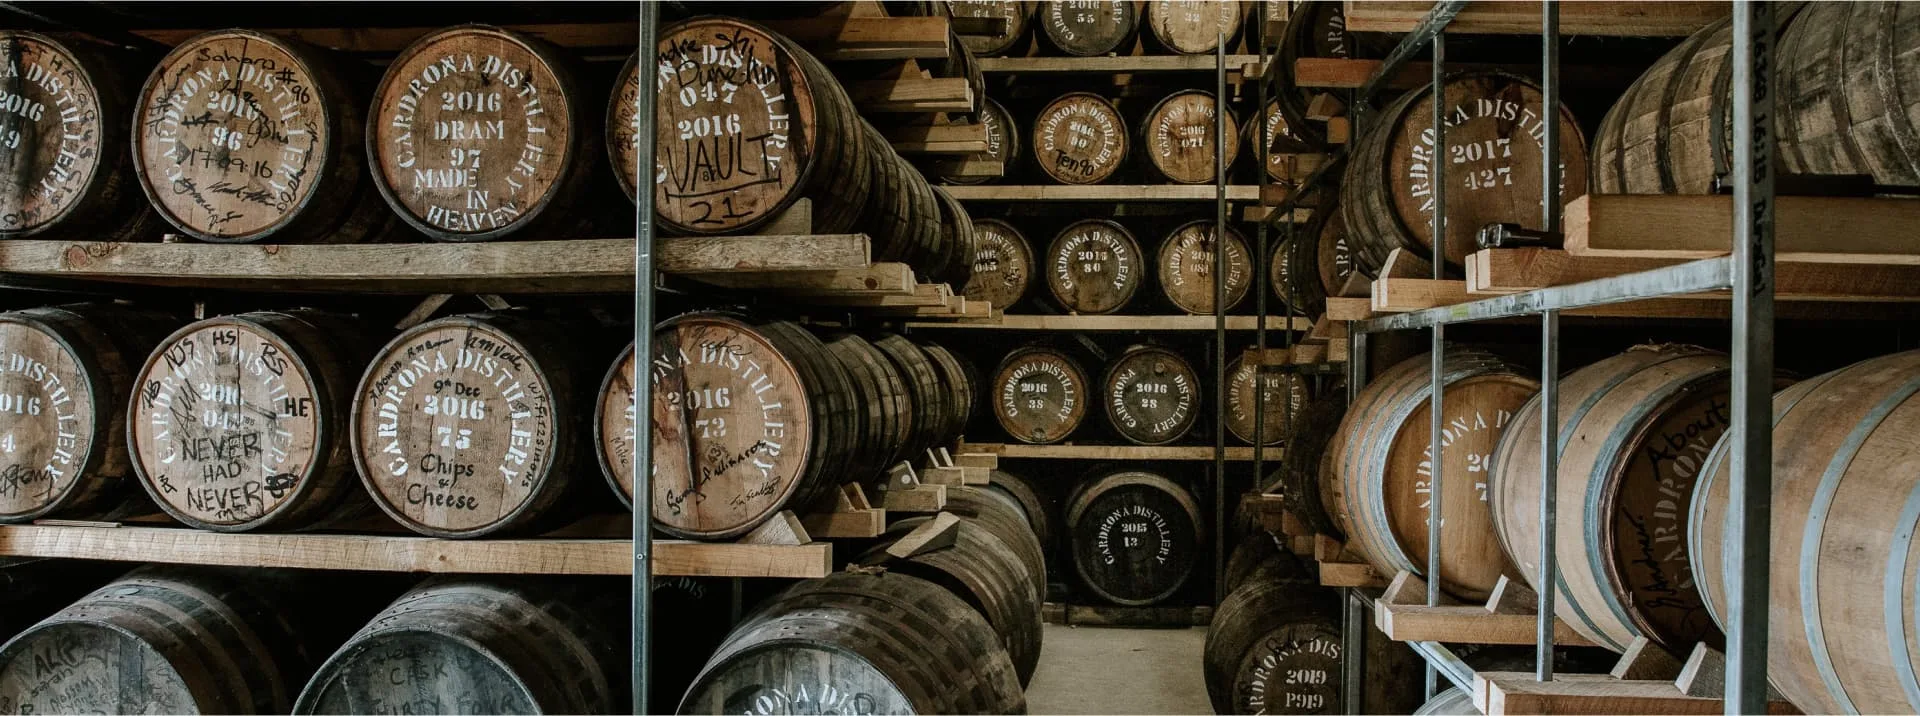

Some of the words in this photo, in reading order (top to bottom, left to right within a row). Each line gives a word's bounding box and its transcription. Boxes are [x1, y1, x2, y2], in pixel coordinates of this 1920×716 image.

[206, 91, 262, 121] 2016
[440, 91, 502, 113] 2016
[679, 81, 738, 107] 047
[26, 62, 81, 199] DISTILLERY
[160, 63, 230, 183] CARDRONA
[239, 64, 306, 197] DISTILLERY
[392, 54, 475, 168] CARDRONA
[482, 55, 546, 195] DISTILLERY
[433, 120, 505, 140] DRAM
[678, 113, 741, 142] 2016
[1044, 104, 1088, 151] CARDRONA
[1090, 105, 1115, 170] DISTILLERY
[211, 127, 244, 151] 96
[1451, 138, 1512, 164] 2017
[449, 147, 481, 169] 97
[667, 132, 774, 192] VAULT
[414, 168, 478, 189] MADE
[1465, 166, 1512, 190] 427
[466, 190, 489, 210] IN
[689, 197, 753, 225] 21
[426, 203, 521, 232] HEAVEN
[976, 250, 997, 260] 016
[1057, 232, 1090, 290] CARDRONA
[1092, 231, 1129, 290] DISTILLERY
[1084, 263, 1101, 273] 80
[455, 382, 481, 397] Dec
[1004, 362, 1038, 418] CARDRONA
[1041, 362, 1074, 424] DISTILLERY
[1021, 383, 1048, 393] 2016
[1136, 383, 1168, 394] 2016
[1250, 378, 1278, 388] 216
[0, 393, 41, 416] 016
[284, 397, 311, 418] HE
[424, 394, 485, 420] 2016
[666, 387, 731, 411] 2016
[700, 343, 784, 477] DISTILLERY
[1113, 367, 1136, 428] CARDRONA
[1152, 374, 1190, 434] DISTILLERY
[10, 353, 76, 484] DISTILLERY
[378, 350, 449, 477] CARDRONA
[456, 348, 532, 485] DISTILLERY
[695, 417, 727, 439] 73
[181, 432, 264, 462] NEVER
[437, 425, 472, 450] 75
[203, 459, 242, 484] HAD
[420, 453, 474, 488] Chips
[187, 480, 263, 512] NEVER
[407, 483, 479, 511] Cheese
[1099, 506, 1131, 565] CARDRONA
[1133, 505, 1171, 565] DISTILLERY
[1121, 523, 1147, 533] 2015
[1285, 669, 1327, 685] 2019
[1285, 692, 1324, 708] P919
